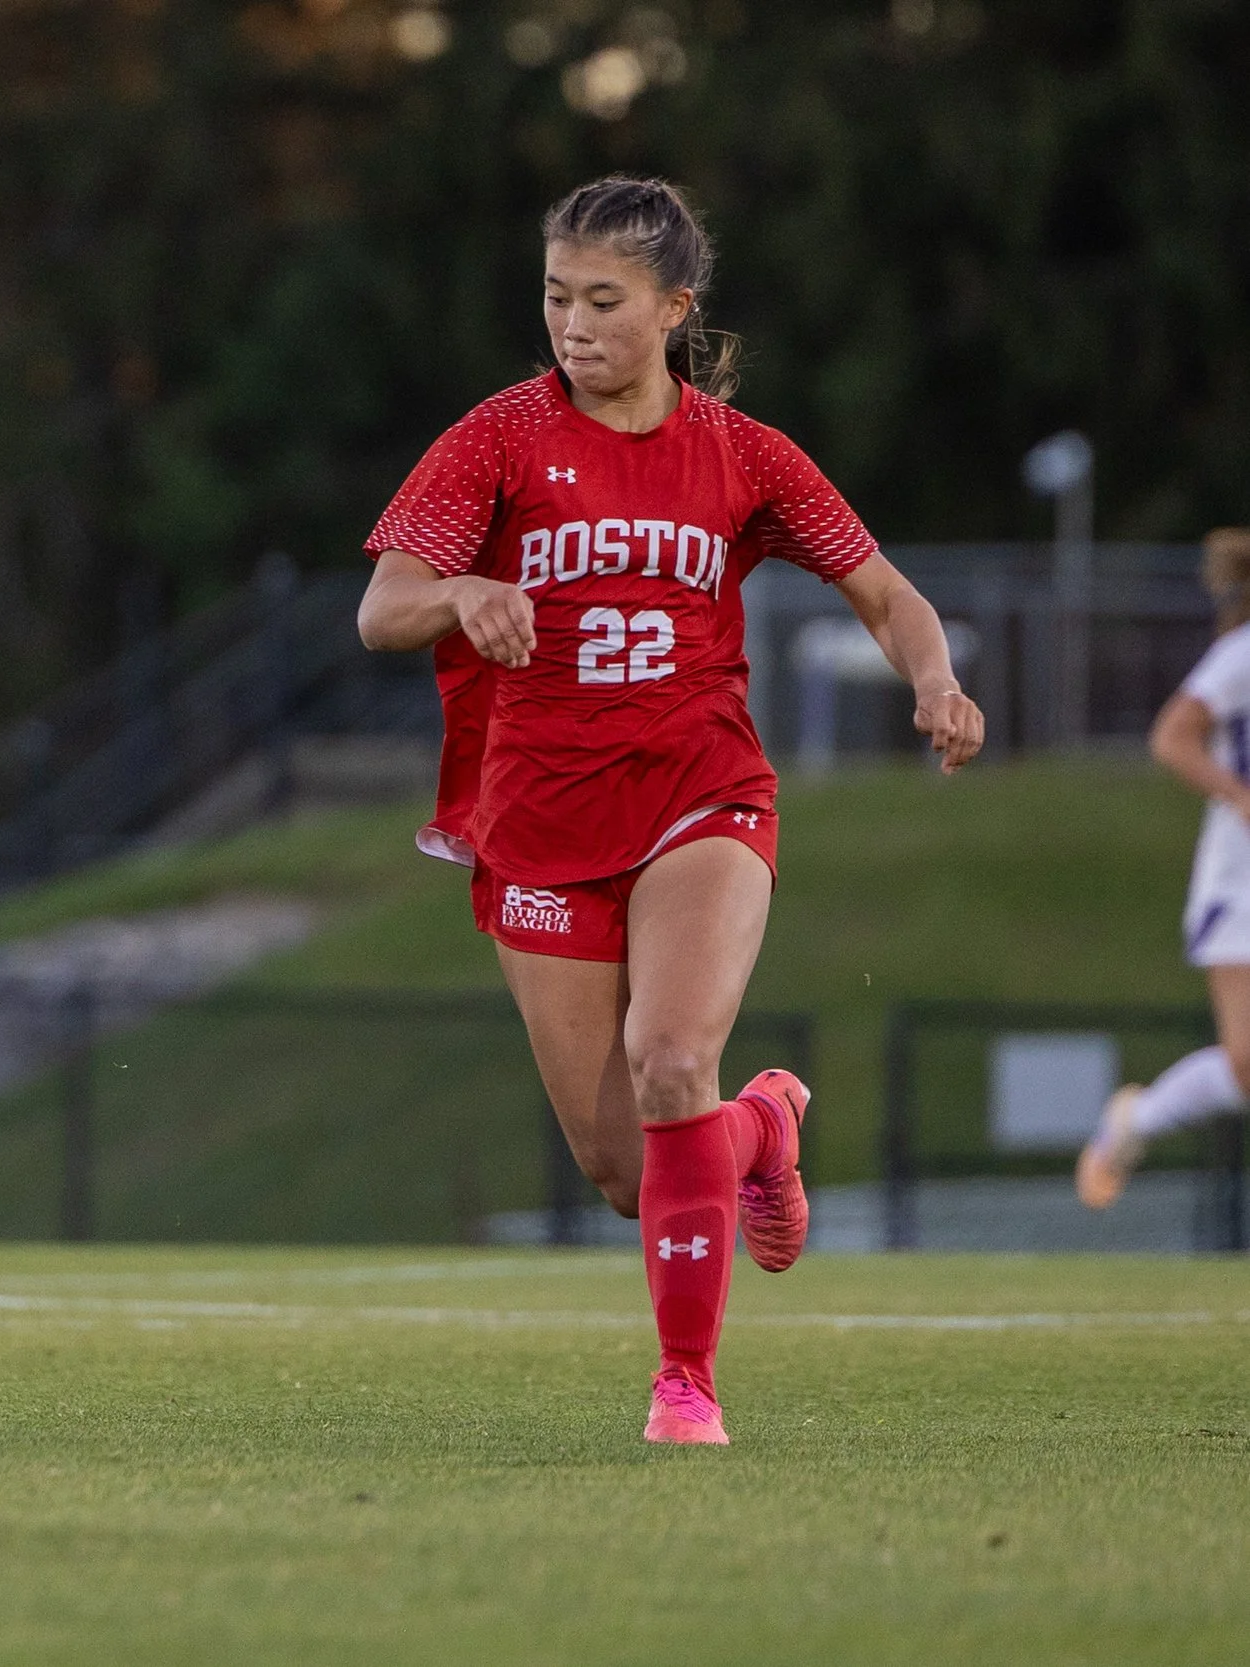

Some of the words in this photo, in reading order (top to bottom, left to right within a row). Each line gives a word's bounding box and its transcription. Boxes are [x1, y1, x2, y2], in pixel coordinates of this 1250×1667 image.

[518, 518, 729, 601] BOSTON
[577, 606, 676, 685] 22
[501, 903, 573, 922] PATRIOT
[501, 914, 572, 934] LEAGUE
